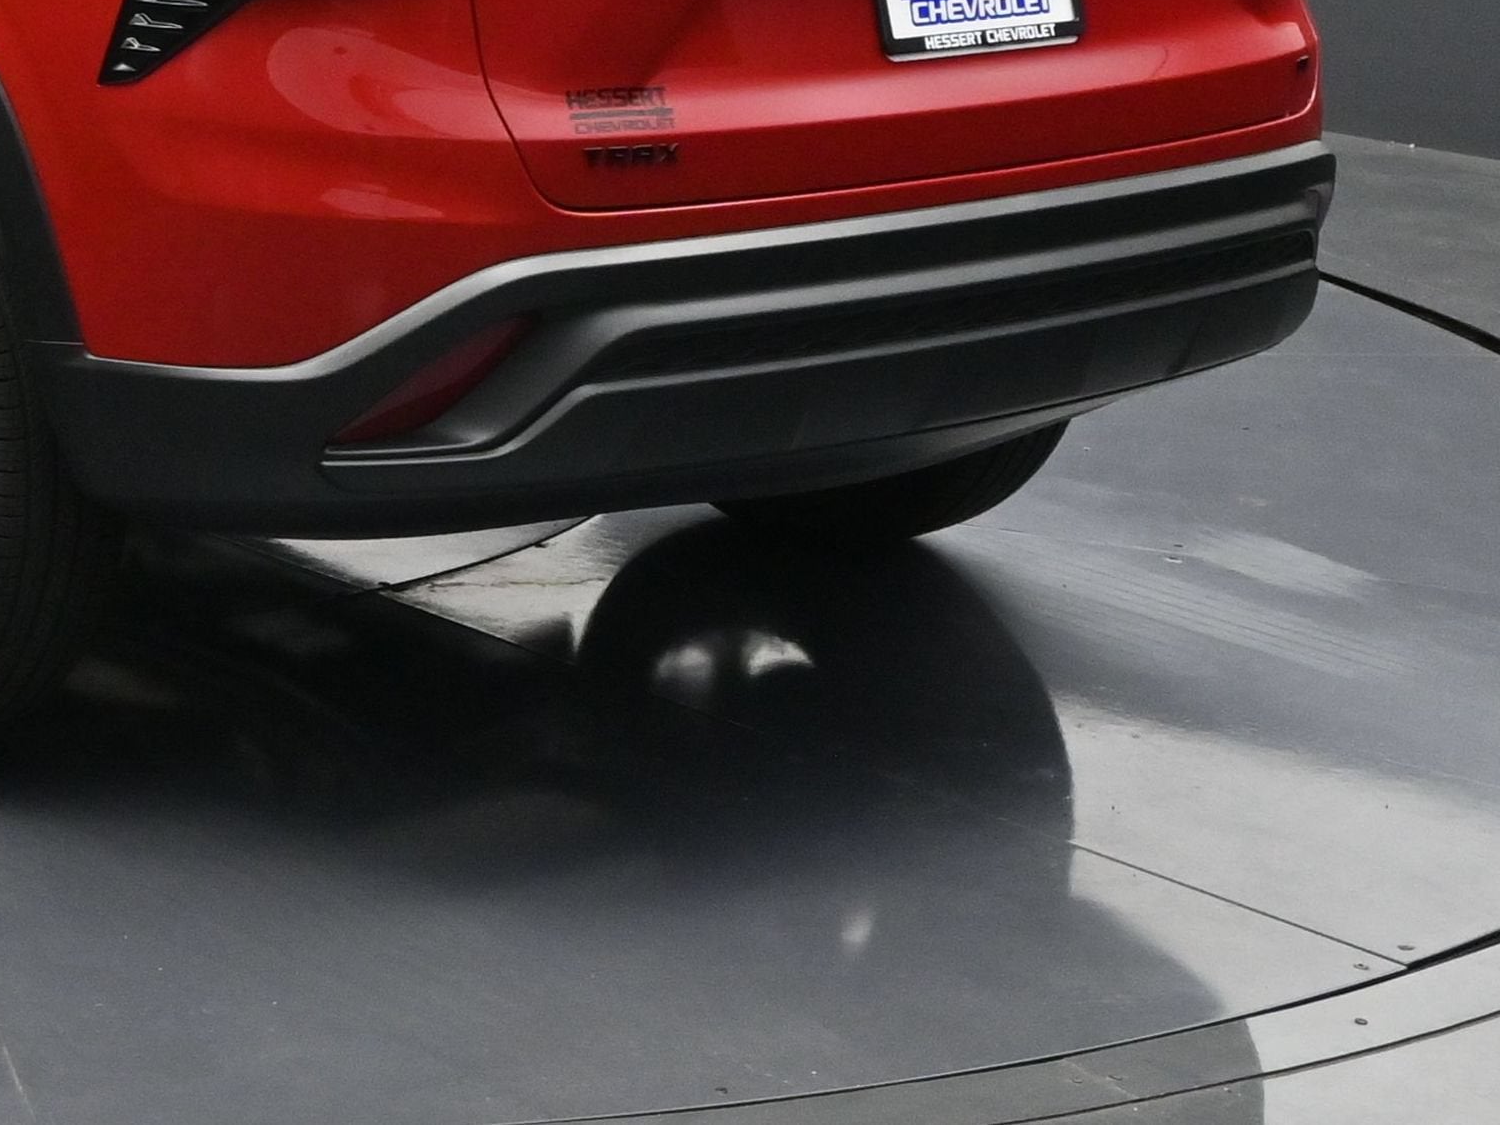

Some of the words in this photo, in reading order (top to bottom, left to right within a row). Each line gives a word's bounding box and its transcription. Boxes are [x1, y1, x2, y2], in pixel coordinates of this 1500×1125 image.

[925, 30, 983, 50] HESSERT
[986, 24, 1056, 44] CHEVROLET
[565, 86, 667, 110] HESSERT
[583, 142, 680, 167] TRAX
